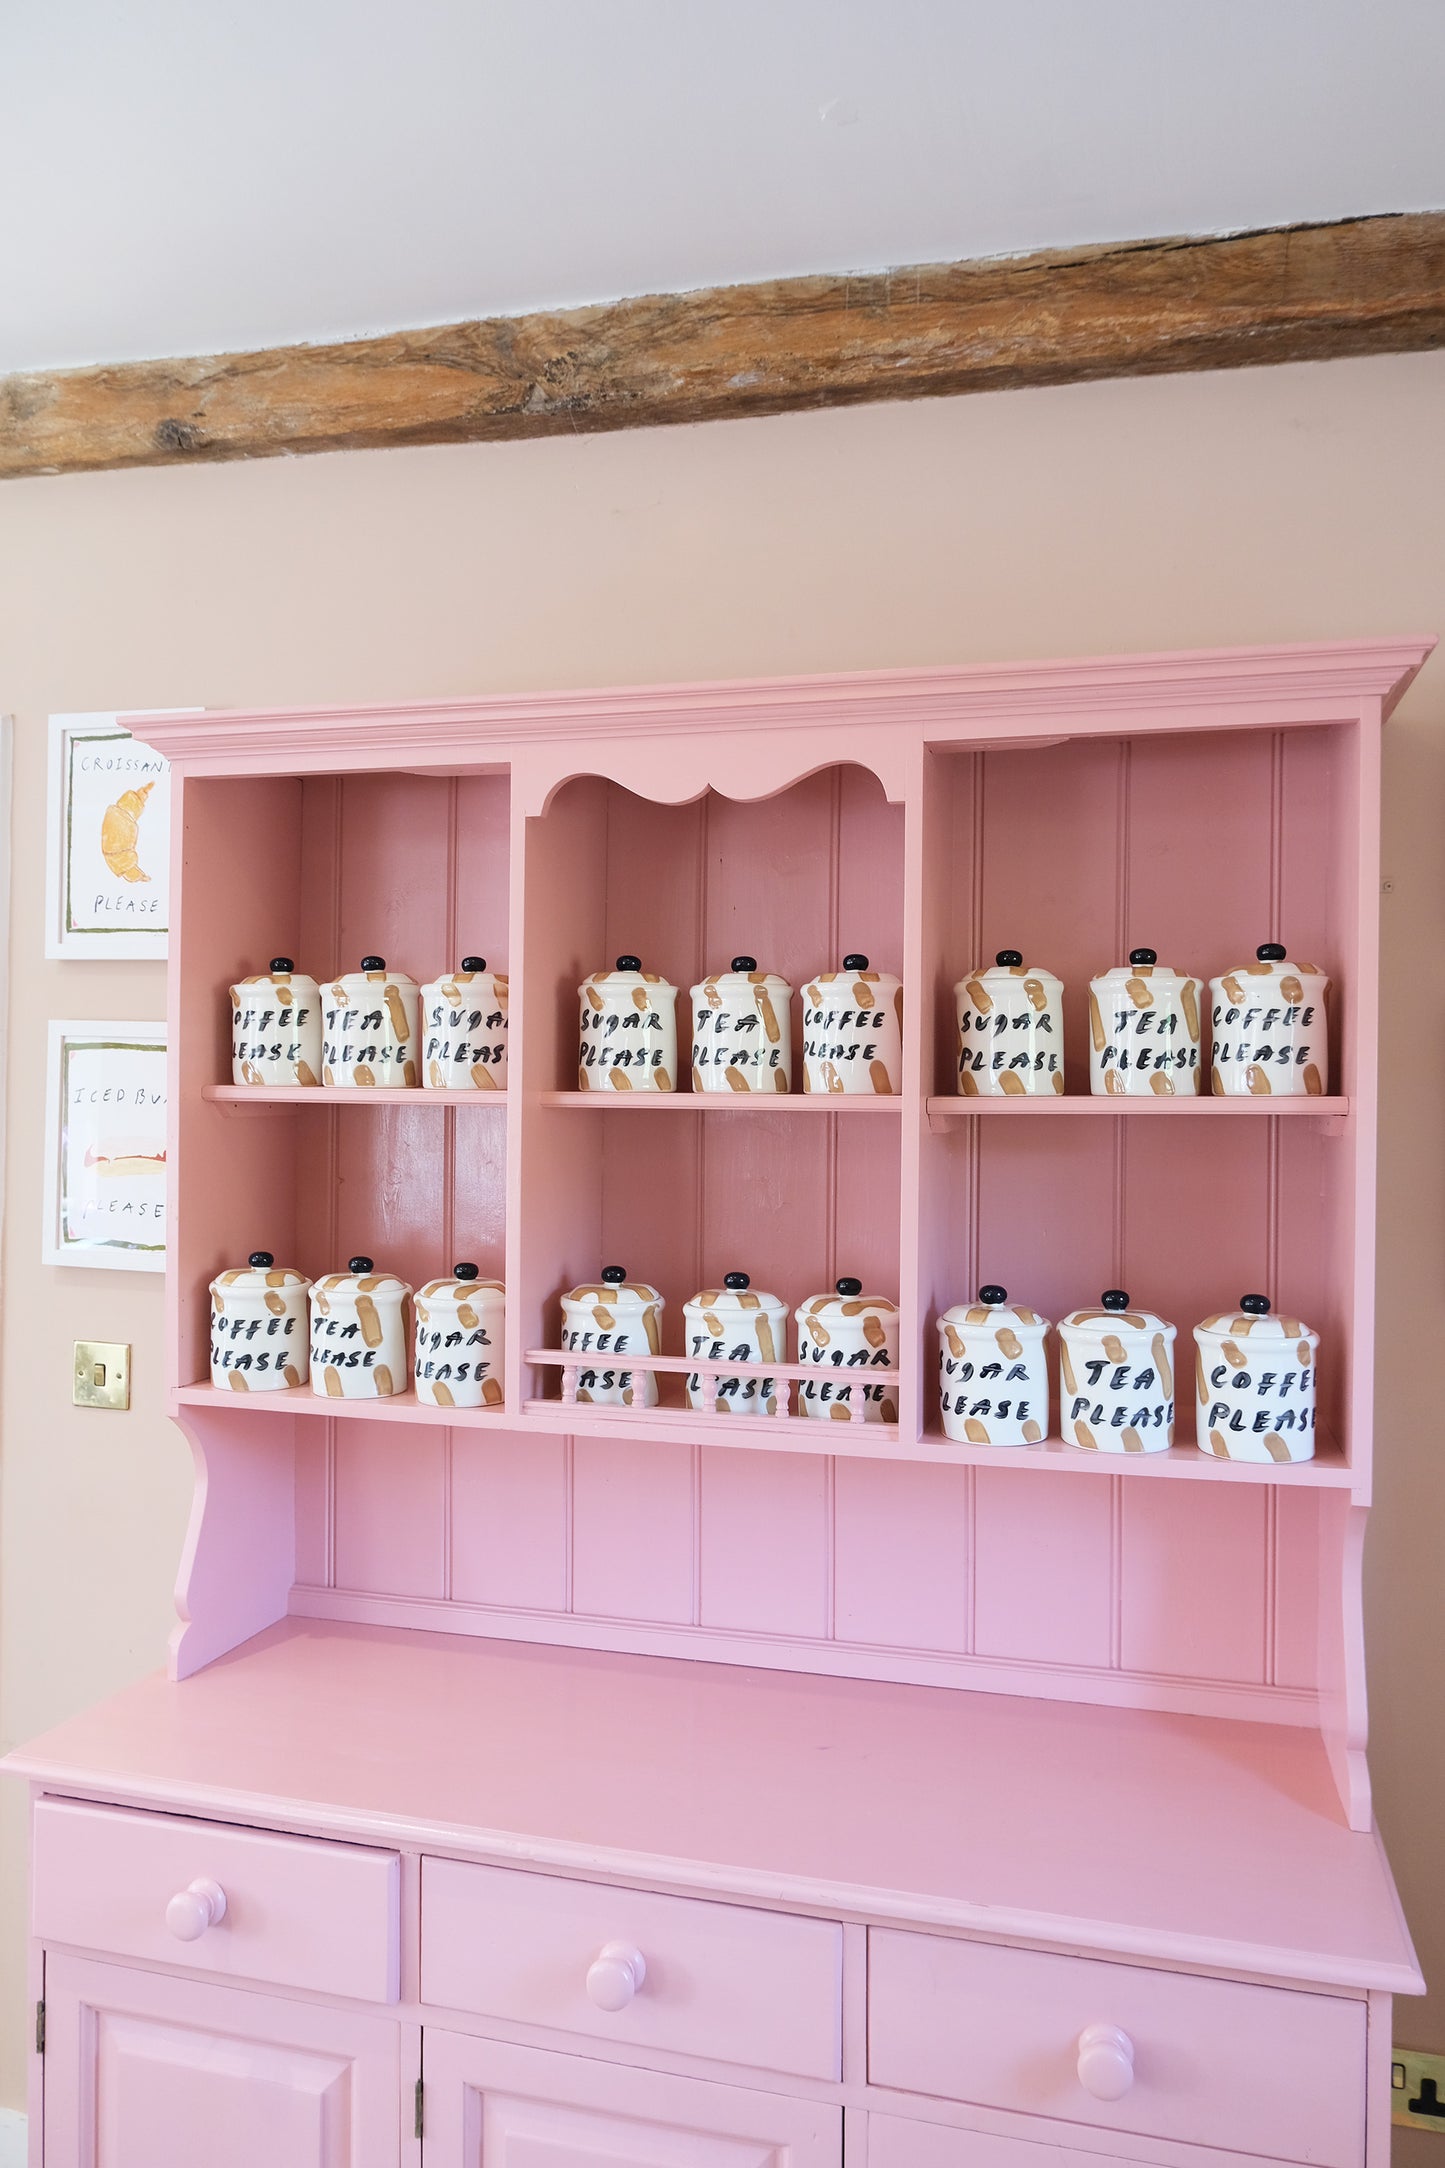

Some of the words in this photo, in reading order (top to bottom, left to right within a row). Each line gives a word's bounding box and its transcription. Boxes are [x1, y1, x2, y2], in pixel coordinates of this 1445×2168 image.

[94, 895, 159, 912] PLEASE
[234, 1009, 310, 1031] OFFEE
[326, 1010, 384, 1030] TEA
[581, 1010, 663, 1038] SUGAR
[697, 1010, 760, 1033] TEA
[804, 1009, 885, 1030] COFFEE
[960, 1010, 1054, 1038] SUGAR
[1114, 1010, 1178, 1035] TEA
[1213, 1006, 1315, 1032] COFFEE
[232, 1042, 302, 1061] LEASE
[323, 1041, 407, 1064] PLEASE
[427, 1038, 508, 1063] PLEAS
[580, 1042, 663, 1066] PLEASE
[693, 1044, 780, 1066] PLEASE
[803, 1042, 878, 1061] PLEASE
[959, 1047, 1059, 1071] PLEASE
[1100, 1045, 1197, 1070] PLEASE
[1211, 1041, 1310, 1065] PLEASE
[74, 1088, 125, 1104] ICED
[135, 1088, 167, 1104] BU
[313, 1317, 361, 1339] TEA
[562, 1329, 629, 1353] OFFEE
[692, 1335, 752, 1361] TEA
[800, 1340, 891, 1367] SUGAR
[415, 1358, 491, 1382] LEASE
[578, 1370, 632, 1390] ASE
[1084, 1360, 1155, 1390] TEA
[686, 1372, 775, 1399] LASE
